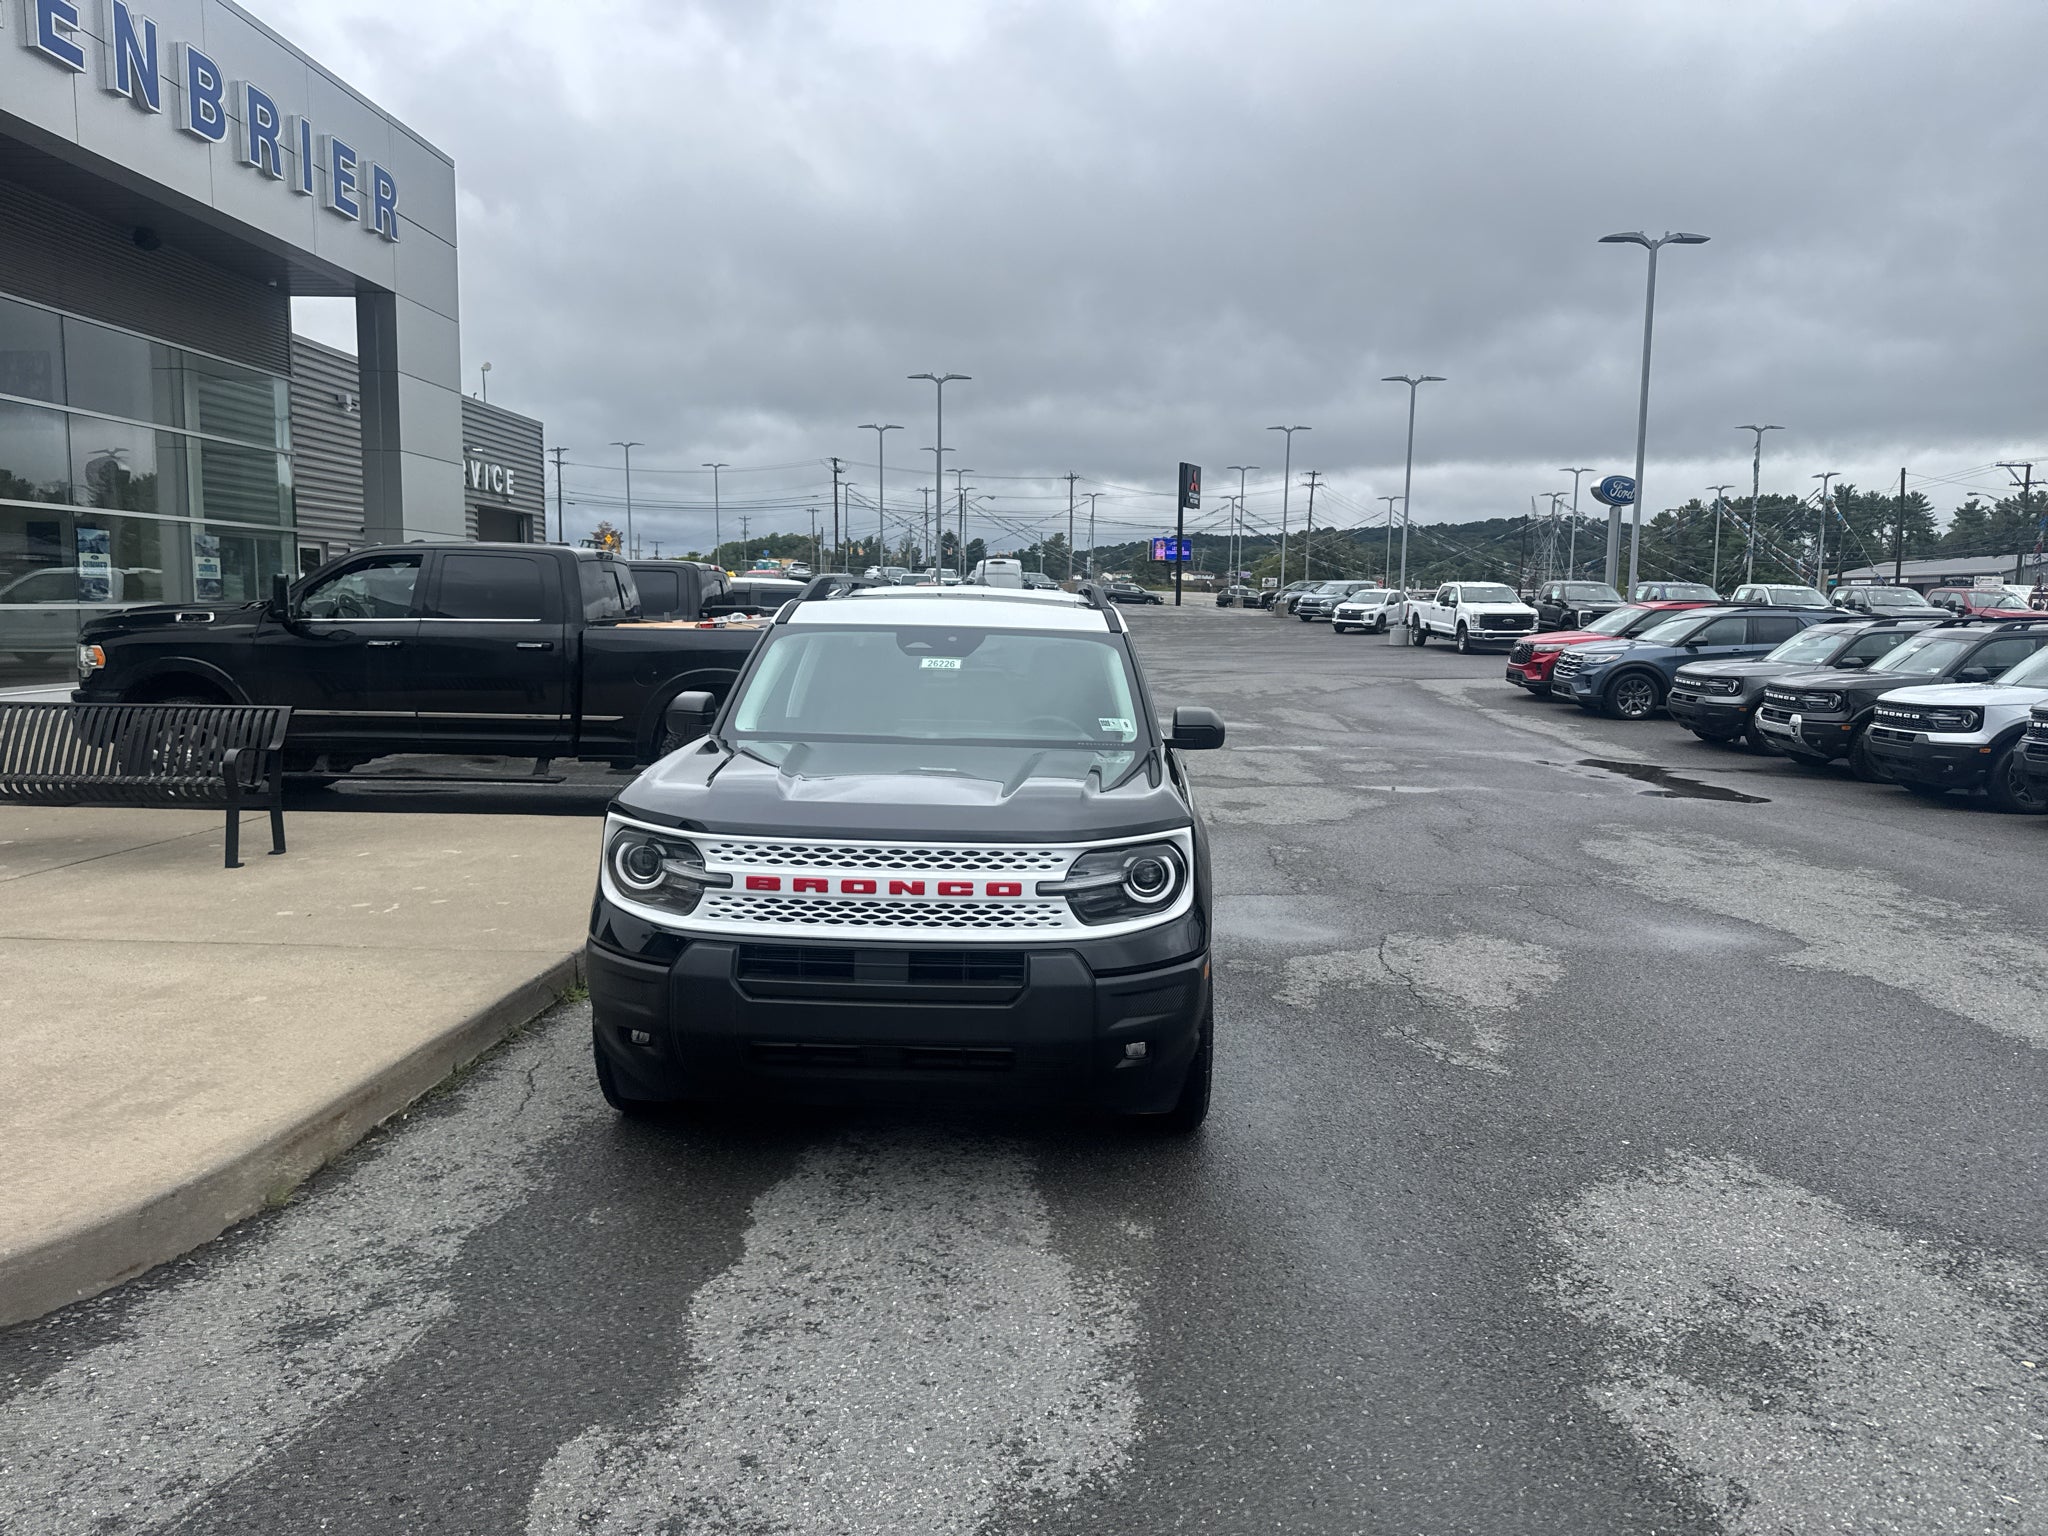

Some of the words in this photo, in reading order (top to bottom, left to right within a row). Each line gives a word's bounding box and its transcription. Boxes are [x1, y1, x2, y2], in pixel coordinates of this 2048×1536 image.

[1609, 480, 1635, 500] Ford
[927, 659, 956, 668] 26226
[1765, 692, 1796, 701] BRONCO
[1877, 709, 1920, 719] BRONCO
[745, 875, 1022, 897] BRONCO
